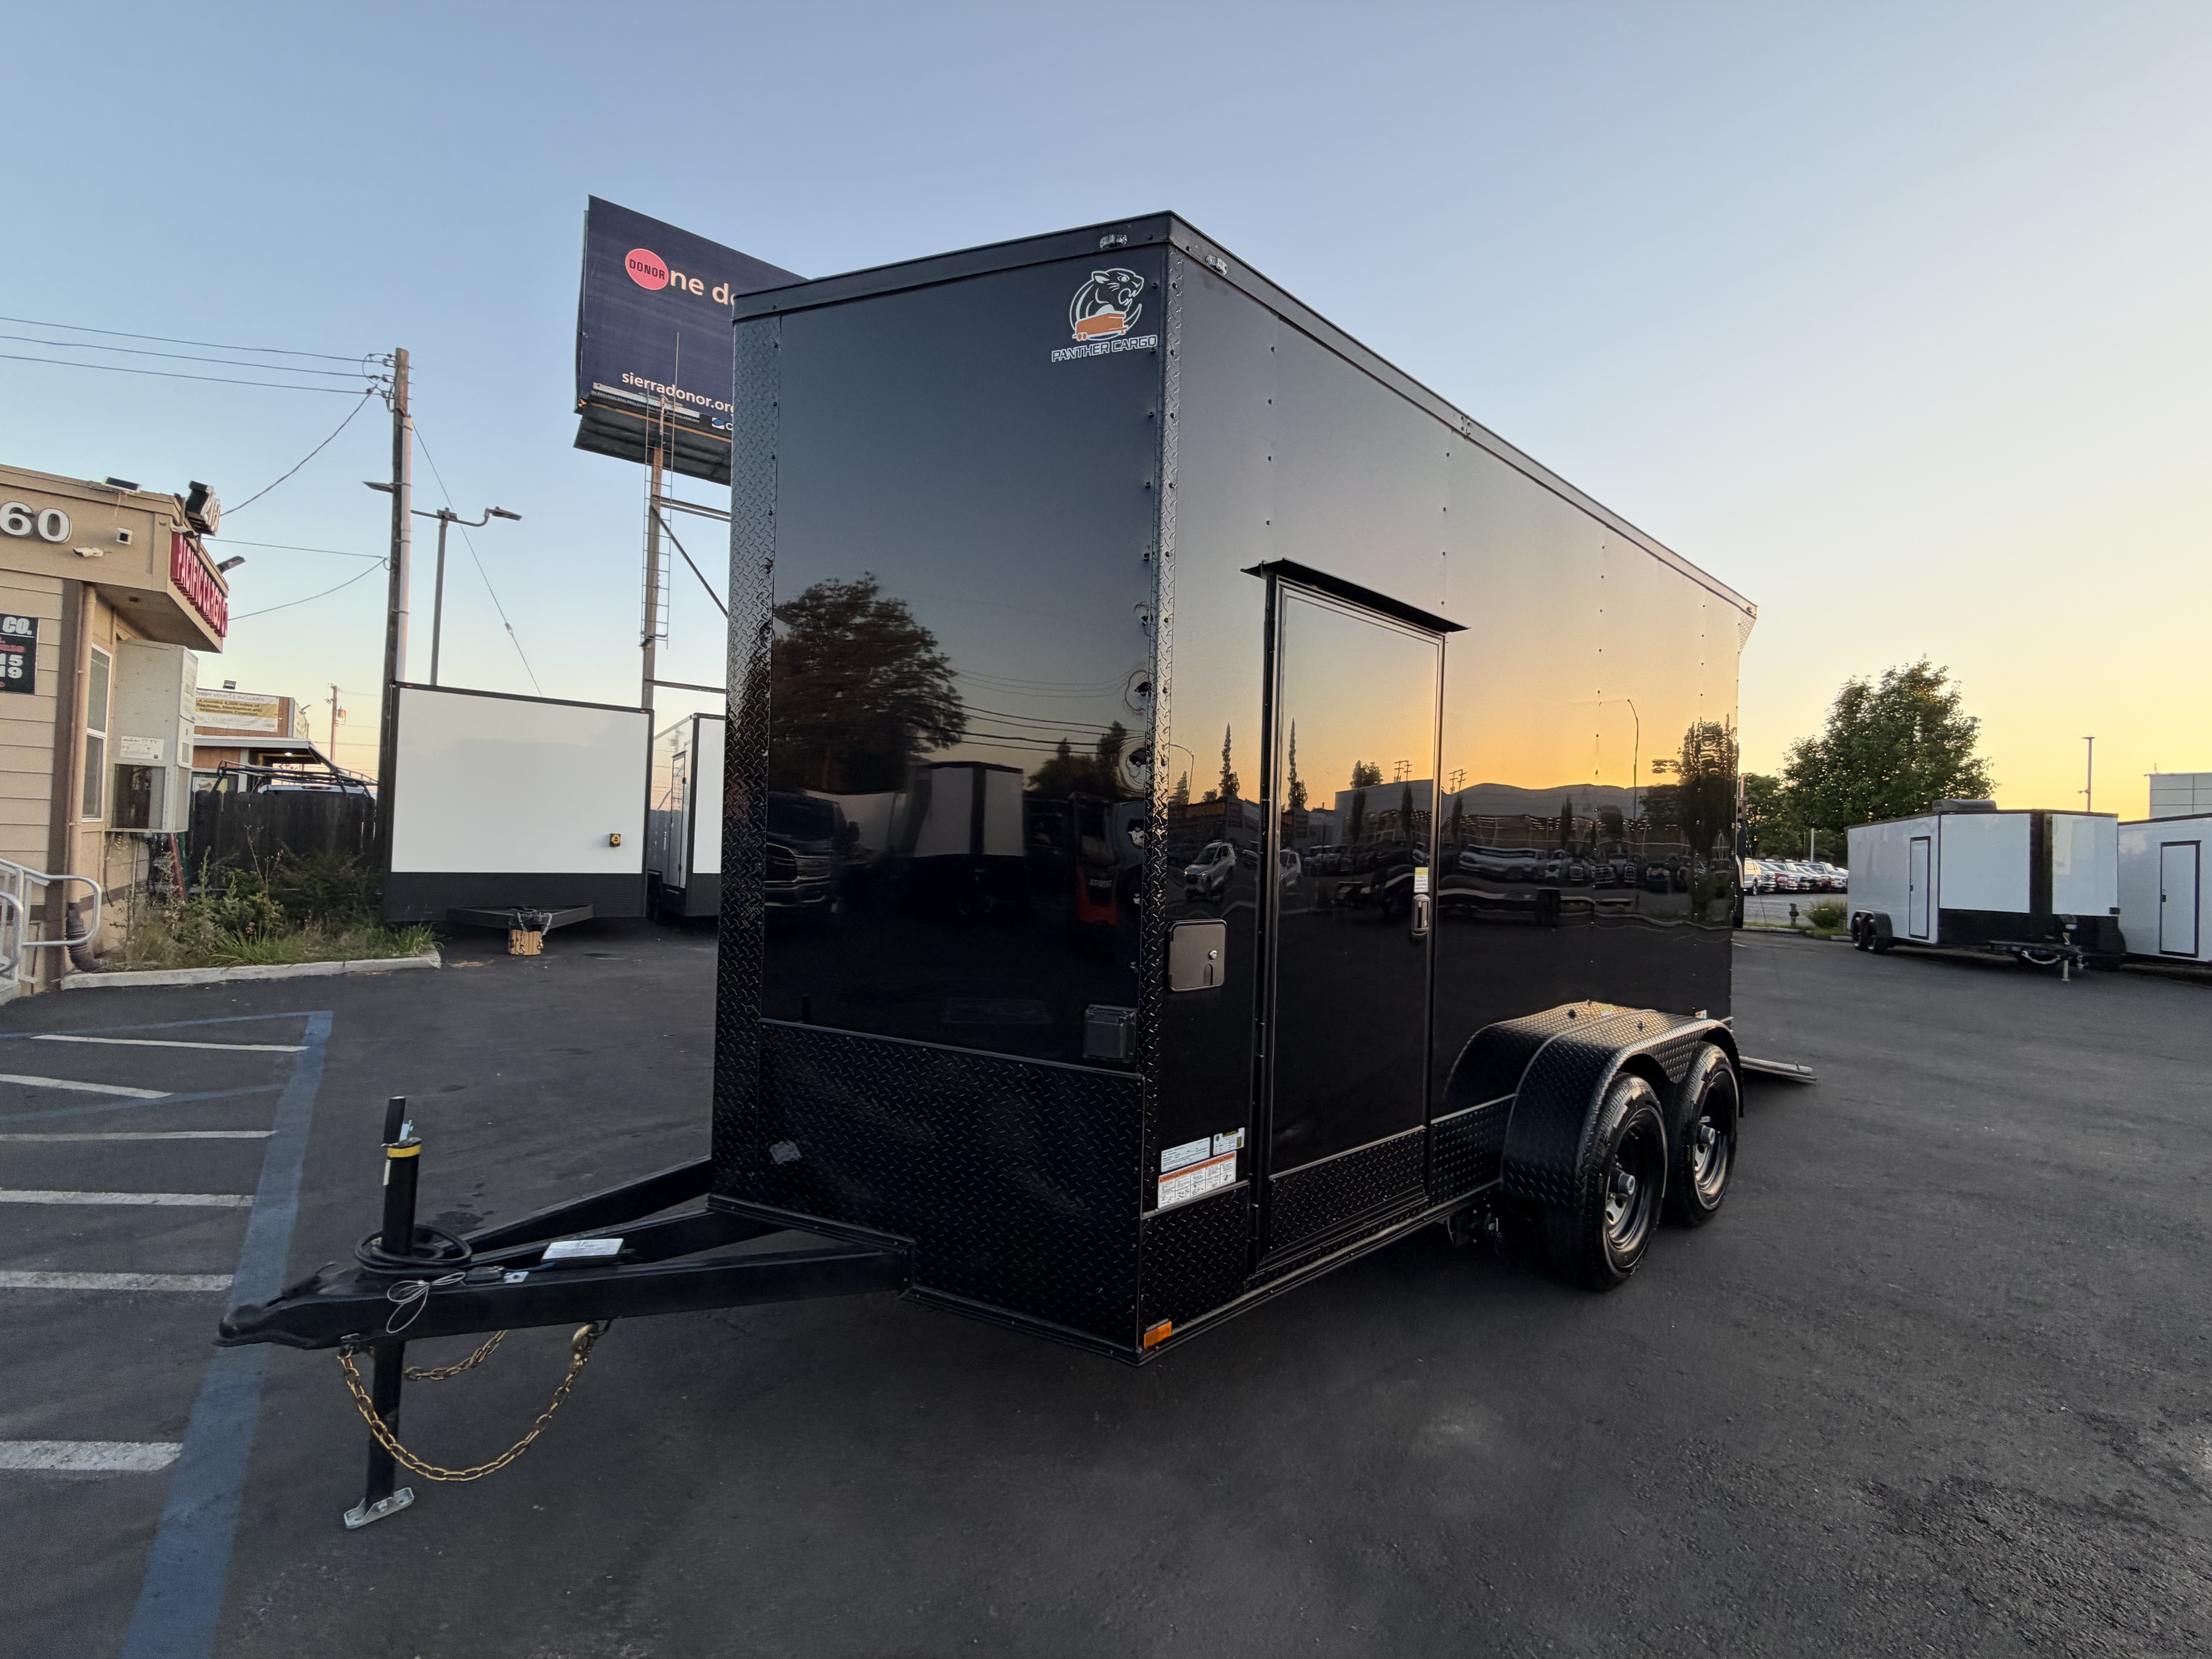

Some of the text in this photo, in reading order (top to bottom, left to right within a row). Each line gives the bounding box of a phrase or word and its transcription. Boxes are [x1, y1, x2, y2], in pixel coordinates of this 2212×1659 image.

[629, 259, 665, 280] DONOR
[670, 270, 704, 295] ne
[1051, 335, 1158, 362] PANTHER CARGO
[622, 372, 733, 416] sierradonor.or
[0, 501, 70, 542] 60
[2, 617, 33, 635] CO.
